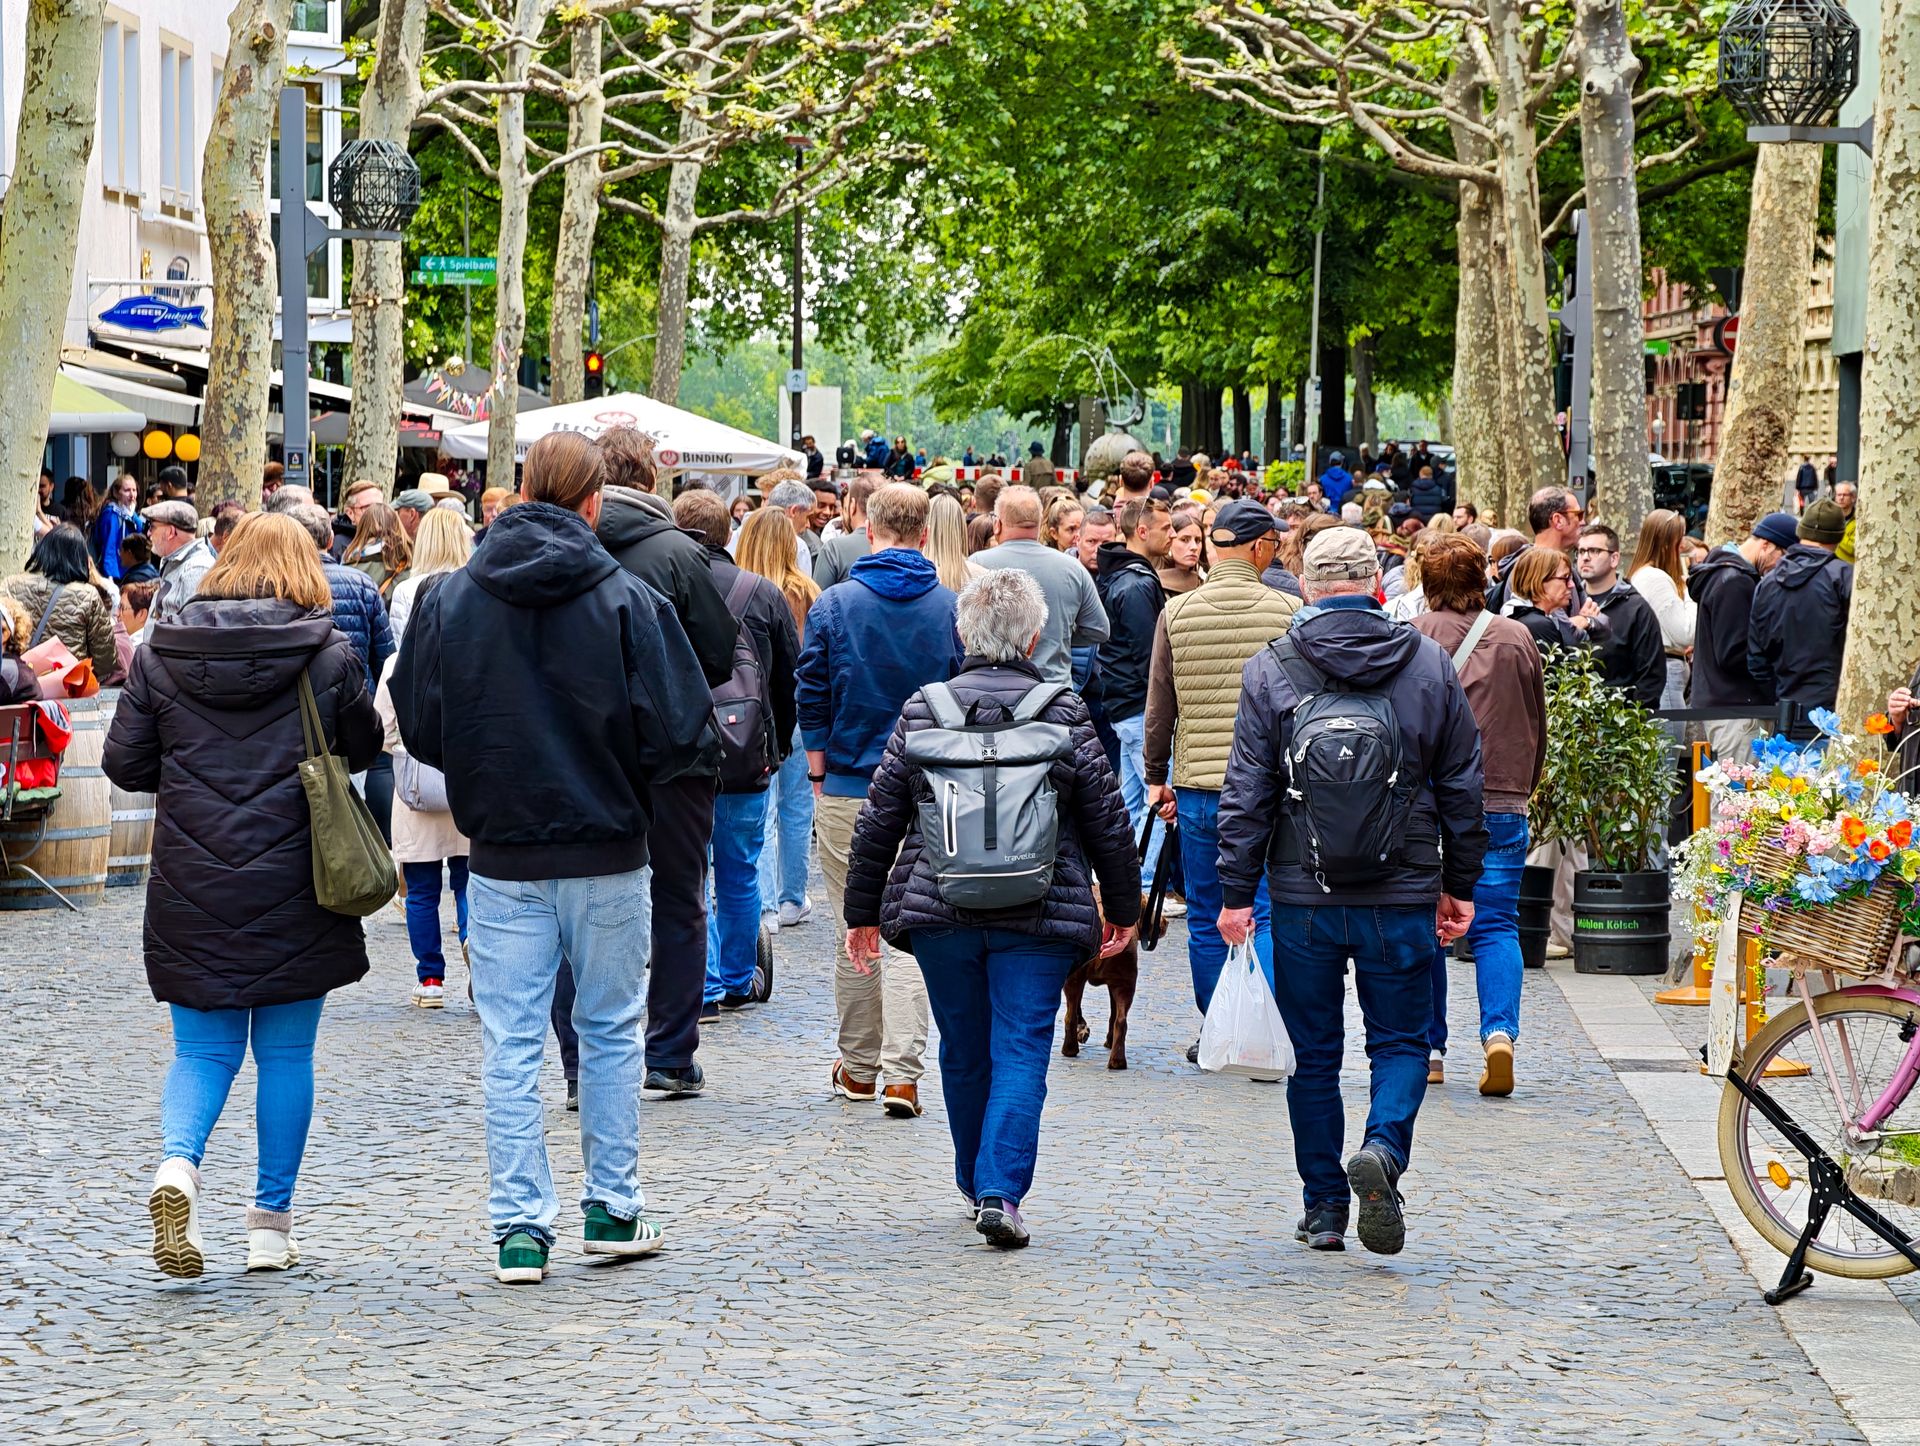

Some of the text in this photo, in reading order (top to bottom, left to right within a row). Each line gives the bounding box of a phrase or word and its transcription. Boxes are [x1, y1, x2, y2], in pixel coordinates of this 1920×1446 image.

[450, 259, 496, 271] Spielbank
[552, 422, 670, 438] BING
[682, 451, 733, 464] BINDING
[1004, 852, 1036, 861] travelite
[1577, 918, 1639, 930] Mühlen Kölsch
